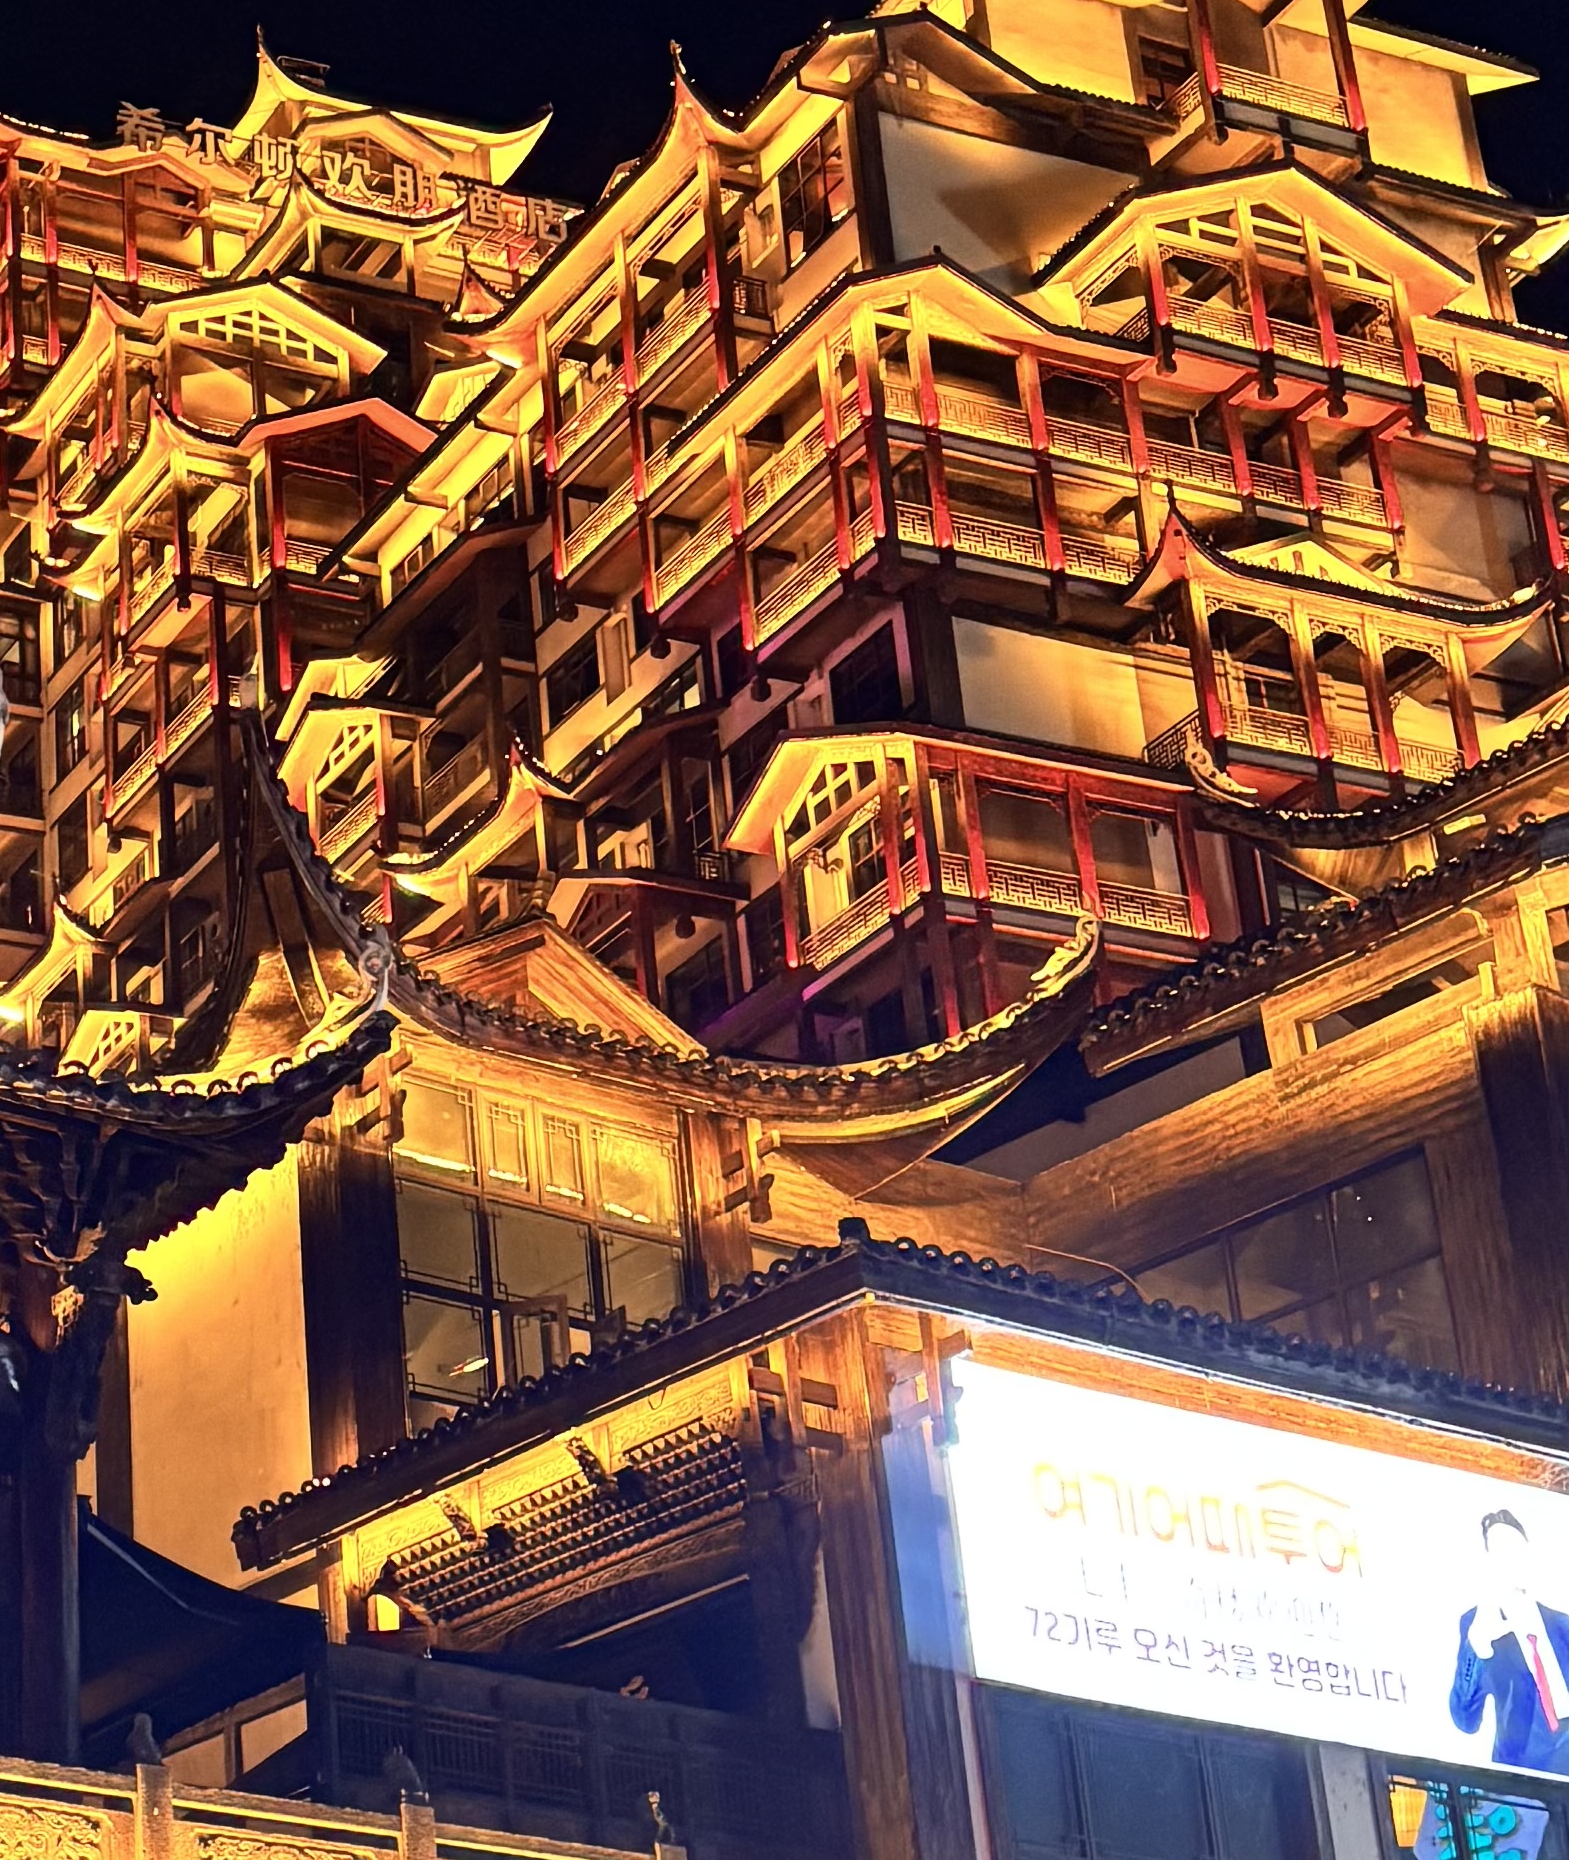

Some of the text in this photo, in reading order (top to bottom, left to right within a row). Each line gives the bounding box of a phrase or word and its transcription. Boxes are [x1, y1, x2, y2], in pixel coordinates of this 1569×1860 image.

[114, 100, 569, 243] 希尔顿欢朋酒店
